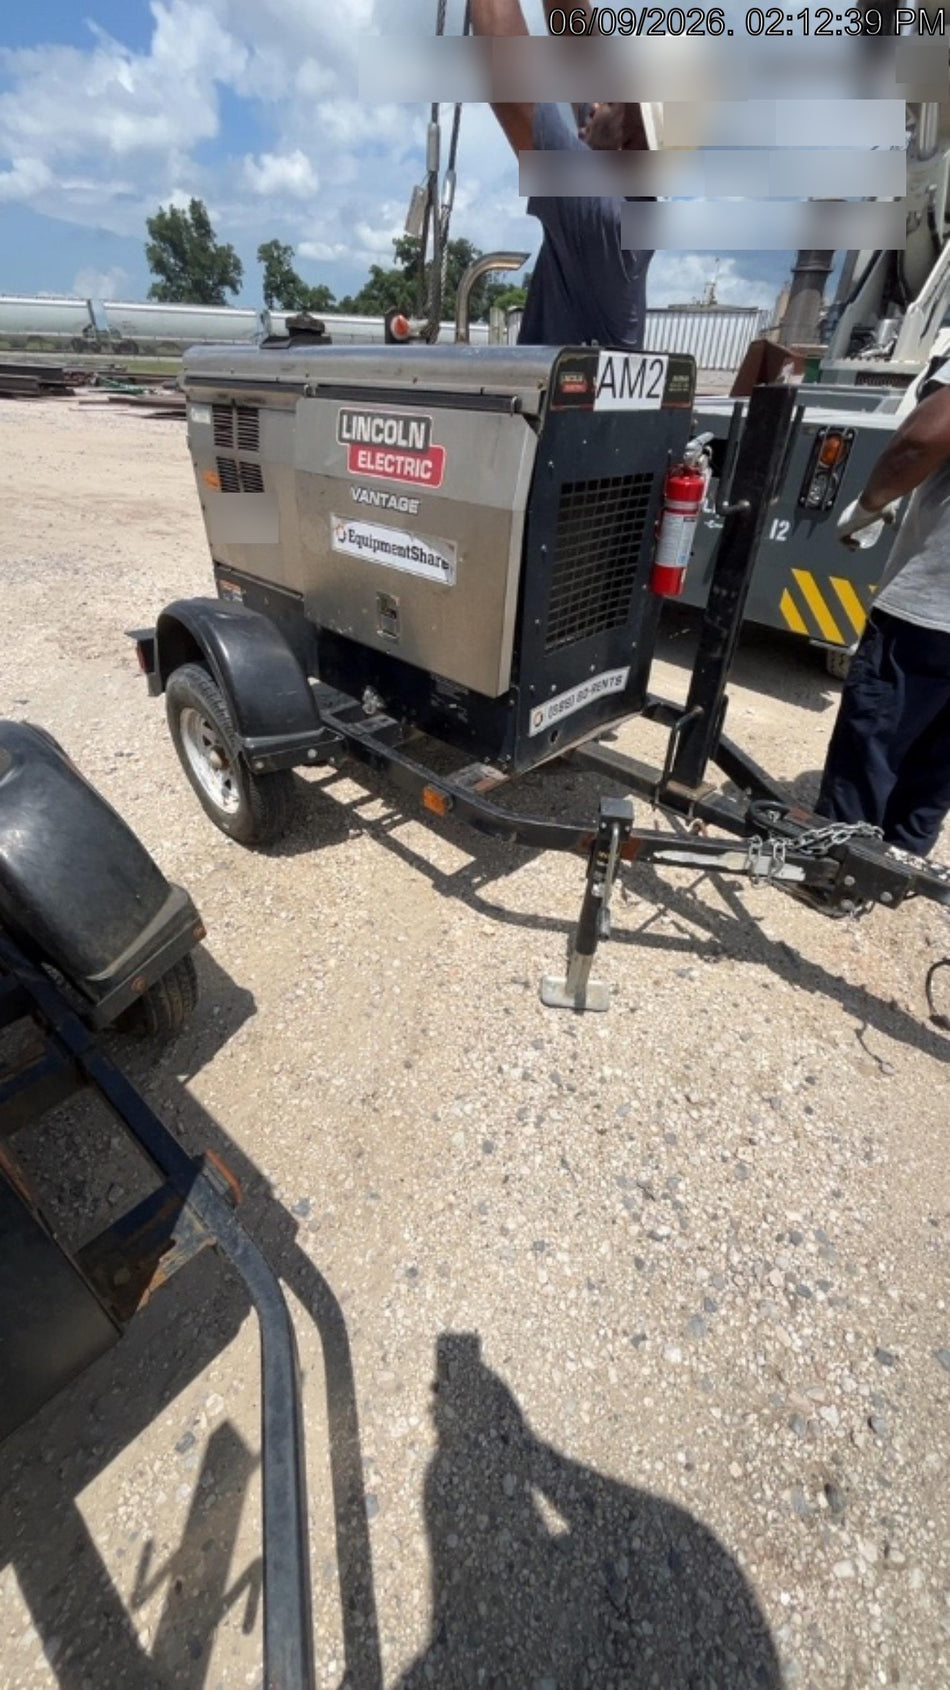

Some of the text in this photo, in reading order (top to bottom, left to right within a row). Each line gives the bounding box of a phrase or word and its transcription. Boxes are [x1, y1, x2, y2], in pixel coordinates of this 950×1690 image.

[596, 356, 664, 399] AM2
[341, 414, 426, 450] LINCOLN
[356, 450, 434, 479] ELECTRIC
[350, 485, 420, 514] VANTAGE
[769, 518, 791, 542] 12
[348, 528, 450, 570] EquipmentShare
